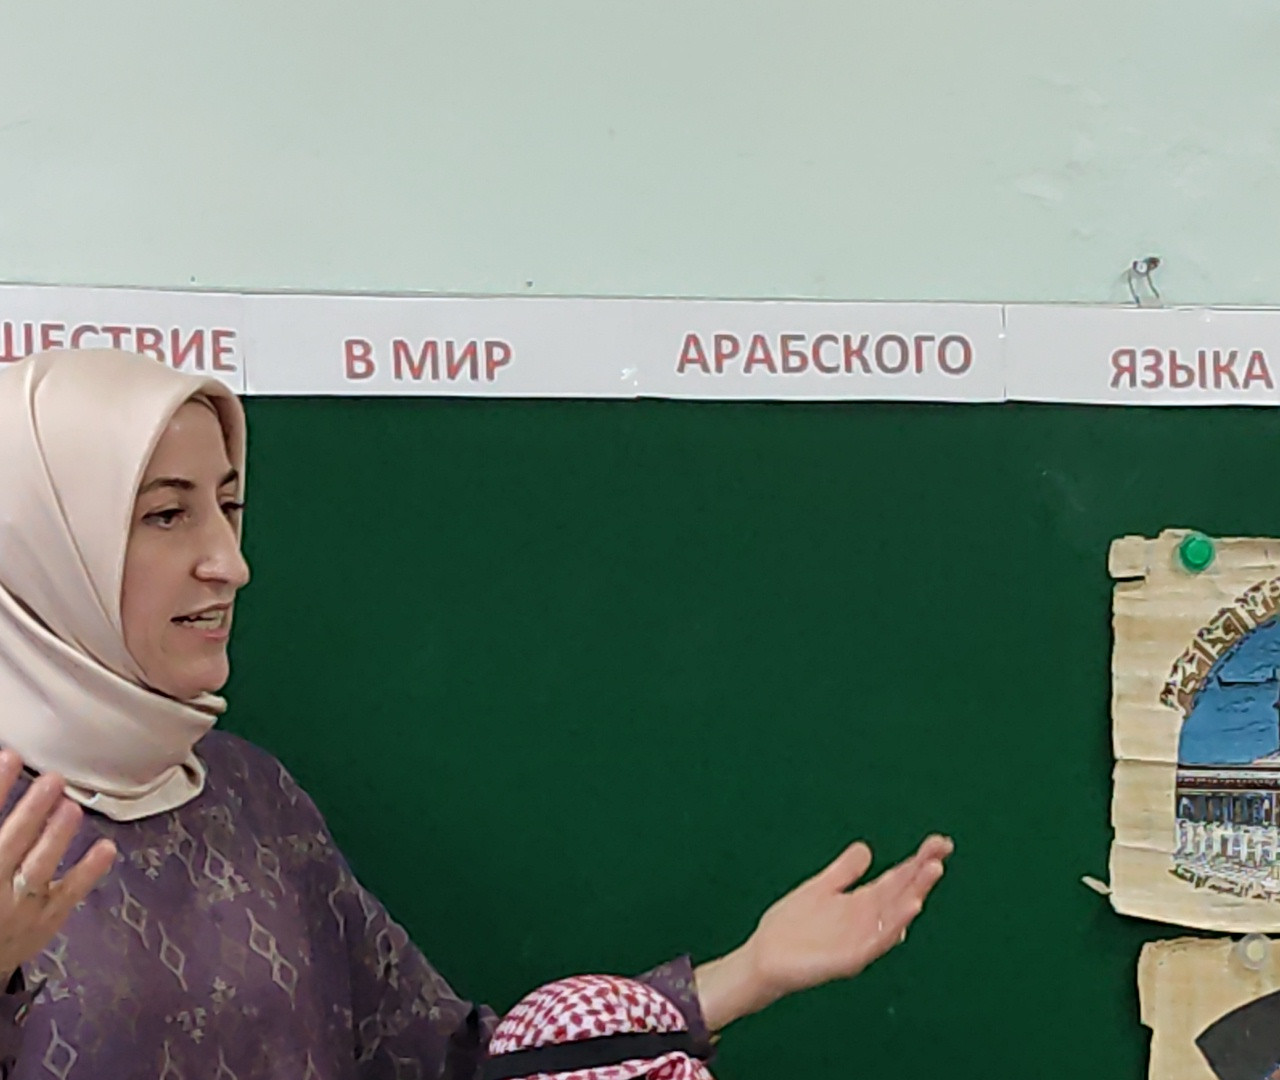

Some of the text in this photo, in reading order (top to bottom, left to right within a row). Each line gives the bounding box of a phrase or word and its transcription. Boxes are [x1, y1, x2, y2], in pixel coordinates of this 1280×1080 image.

[344, 338, 376, 380] В
[393, 339, 513, 382] МИР
[675, 331, 974, 375] АРАБСКОГО
[1109, 347, 1275, 390] ЯЗЫКА
